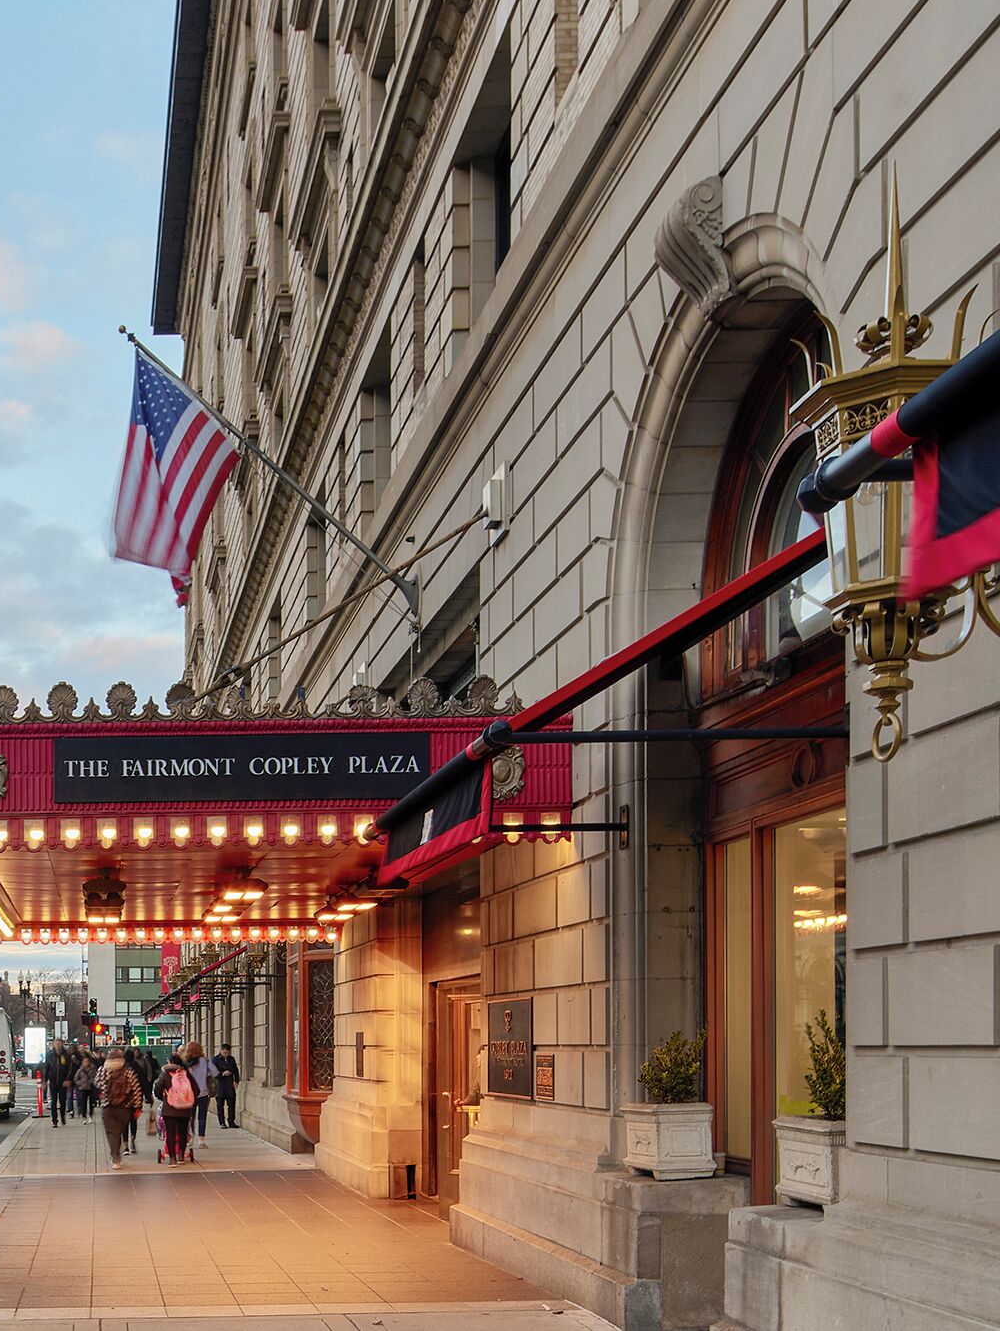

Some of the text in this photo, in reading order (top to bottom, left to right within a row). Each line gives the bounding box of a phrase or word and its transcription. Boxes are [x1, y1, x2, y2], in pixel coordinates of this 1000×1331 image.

[64, 754, 421, 778] THE FAIRMONT COPLEY PLAZA
